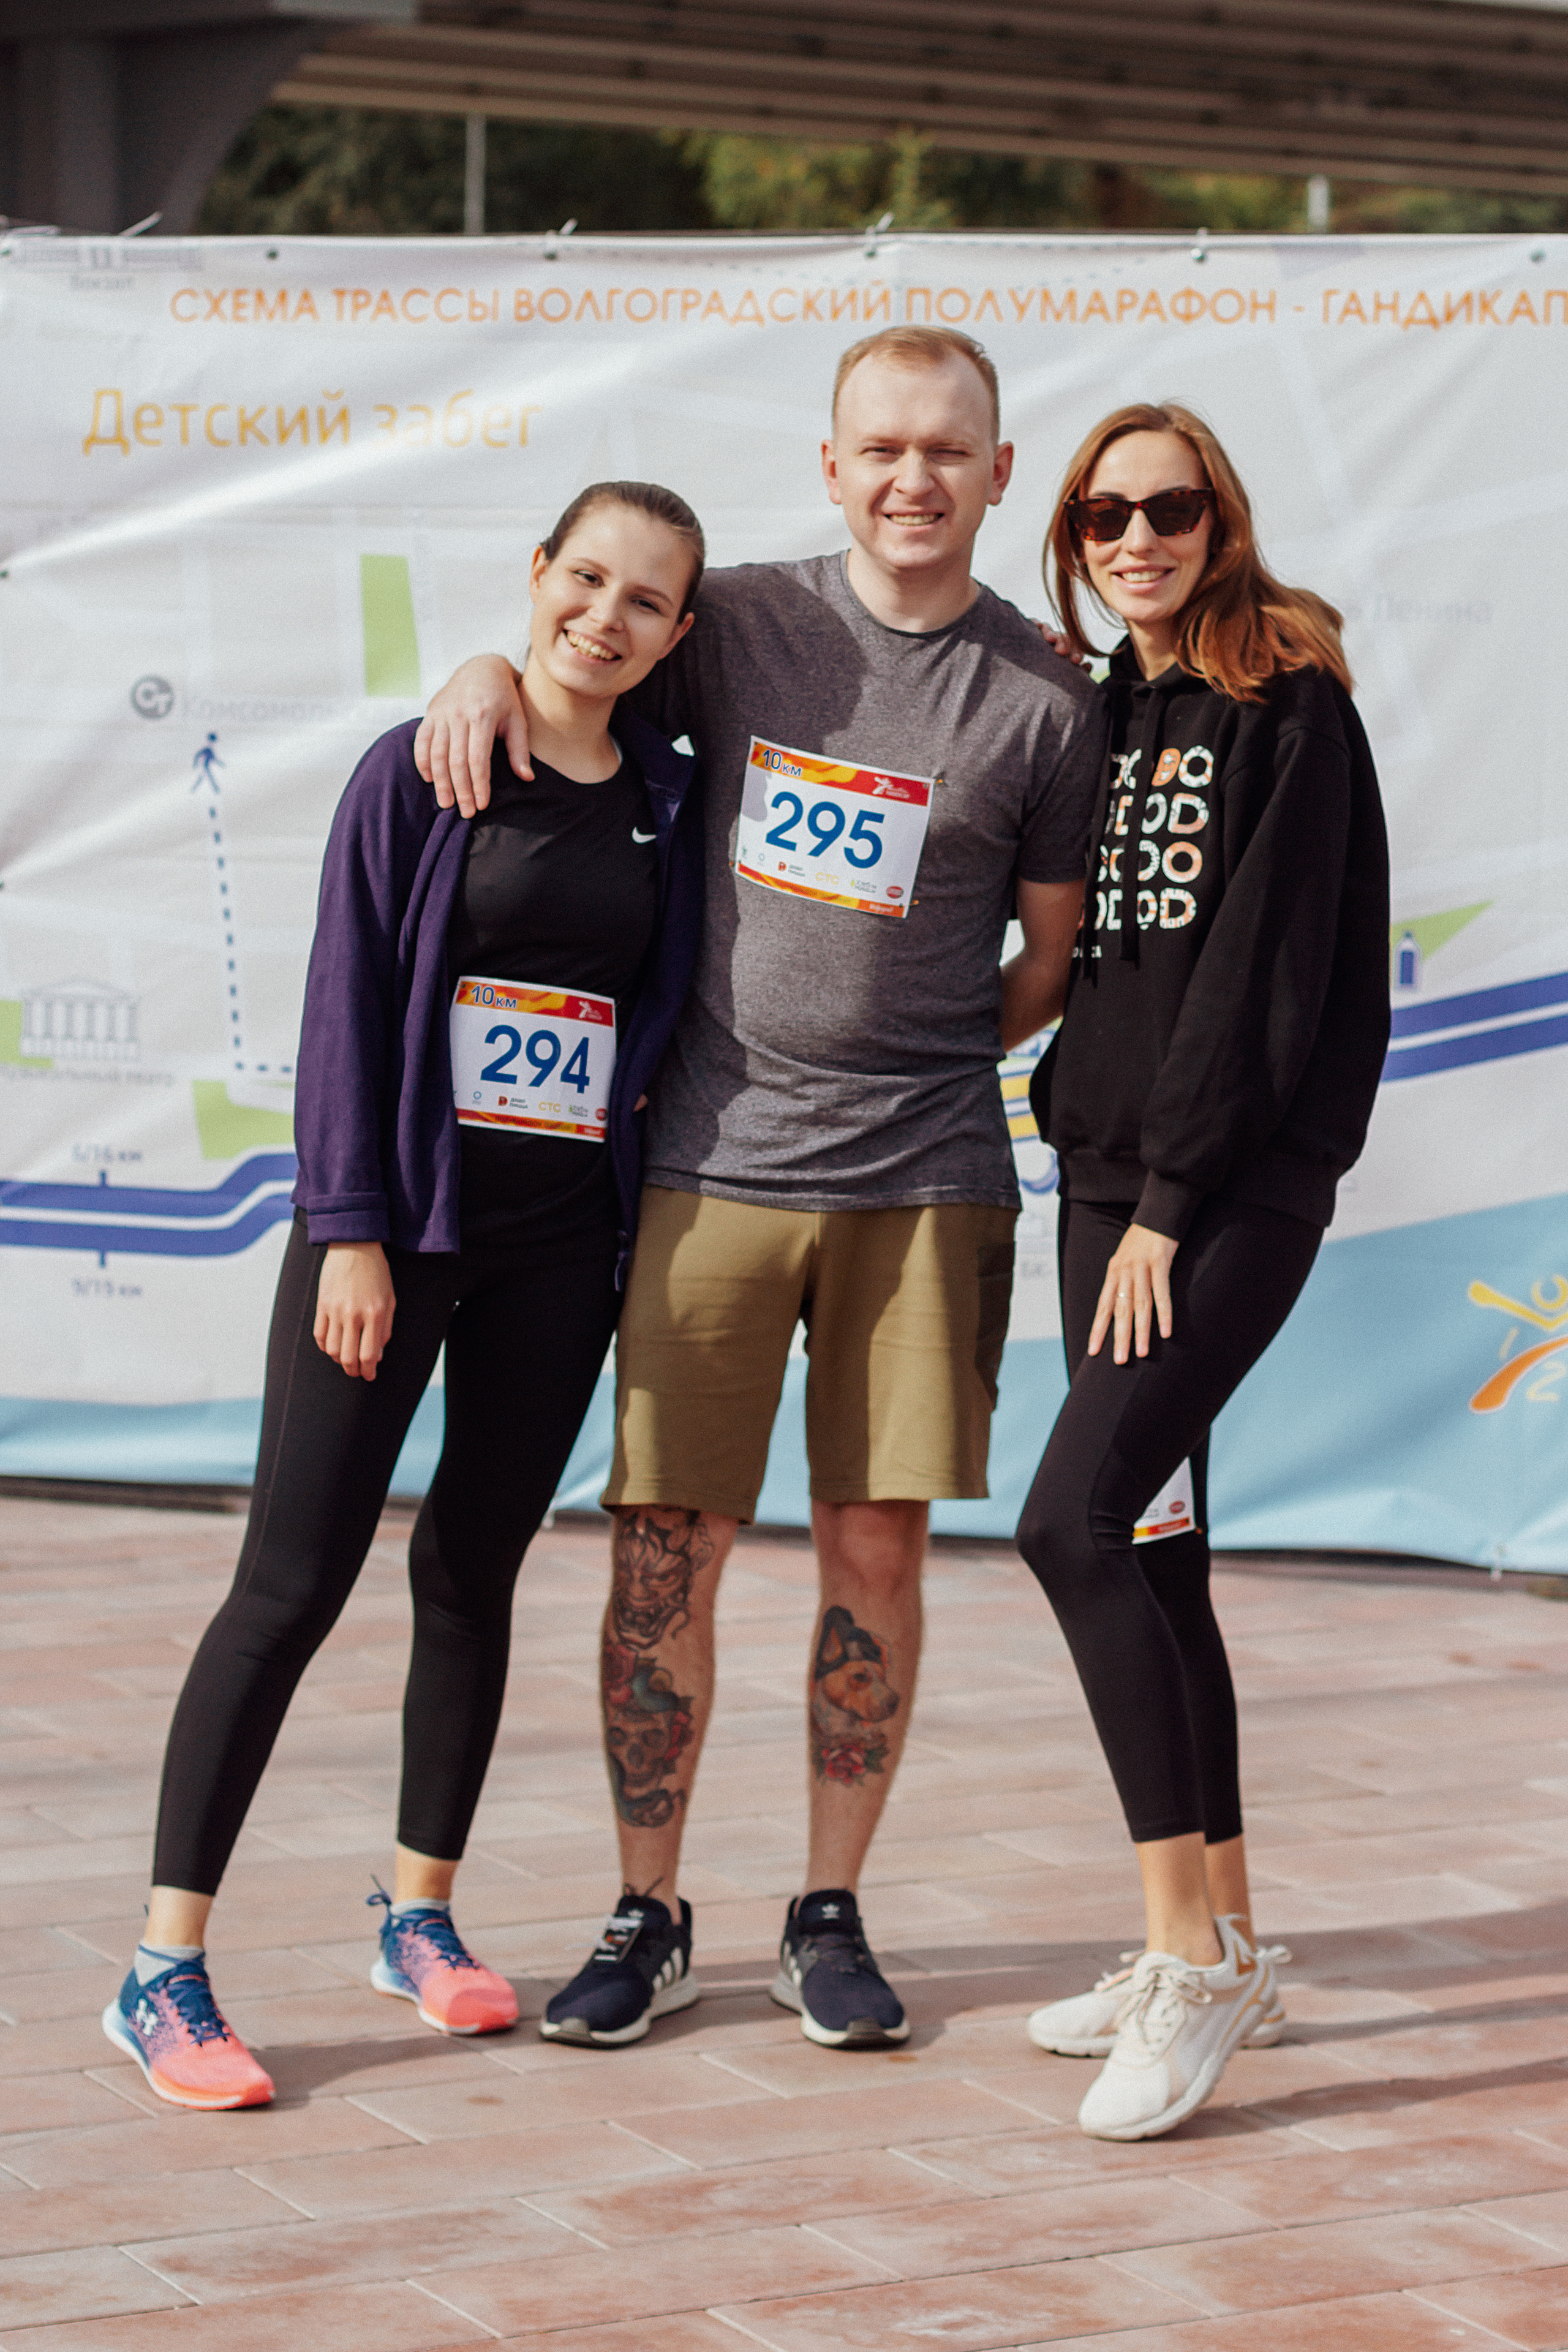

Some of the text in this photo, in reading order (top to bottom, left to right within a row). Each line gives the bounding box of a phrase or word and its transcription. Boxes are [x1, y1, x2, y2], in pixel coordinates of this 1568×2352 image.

[171, 288, 320, 323] СХЕМА
[333, 288, 500, 323] ТРАССЫ
[514, 280, 891, 326] ВОЛГОГРАДСКИЙ
[907, 287, 1276, 325] ПОЛУМАРАФОН
[1322, 288, 1568, 331] ГАНДИКАП
[82, 389, 543, 456] Детский забег
[765, 791, 885, 869] 295
[480, 1025, 590, 1094] 294
[538, 1101, 561, 1114] СТС
